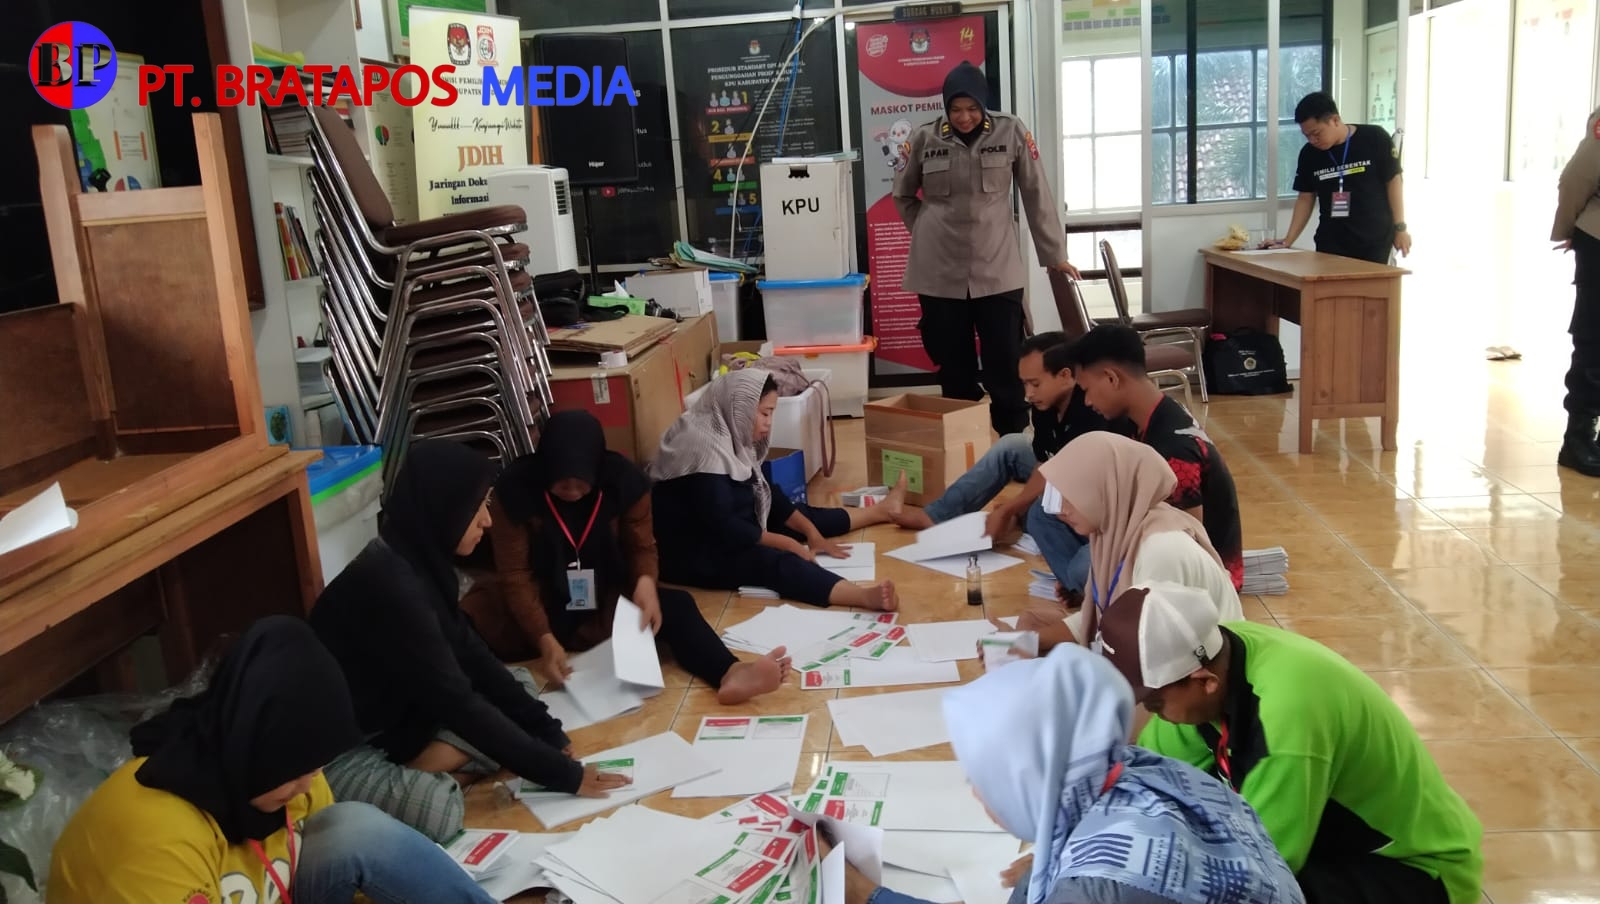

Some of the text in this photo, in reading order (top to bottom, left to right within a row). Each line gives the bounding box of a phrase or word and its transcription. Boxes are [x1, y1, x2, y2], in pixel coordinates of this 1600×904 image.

[741, 91, 748, 104] 1
[870, 101, 944, 116] MASKOT PEMIL
[712, 120, 720, 134] 2
[457, 144, 504, 172] JDIH
[713, 168, 722, 181] 4
[1313, 167, 1335, 176] PEMILU
[429, 179, 466, 191] Jaringan
[781, 197, 820, 215] KPU
